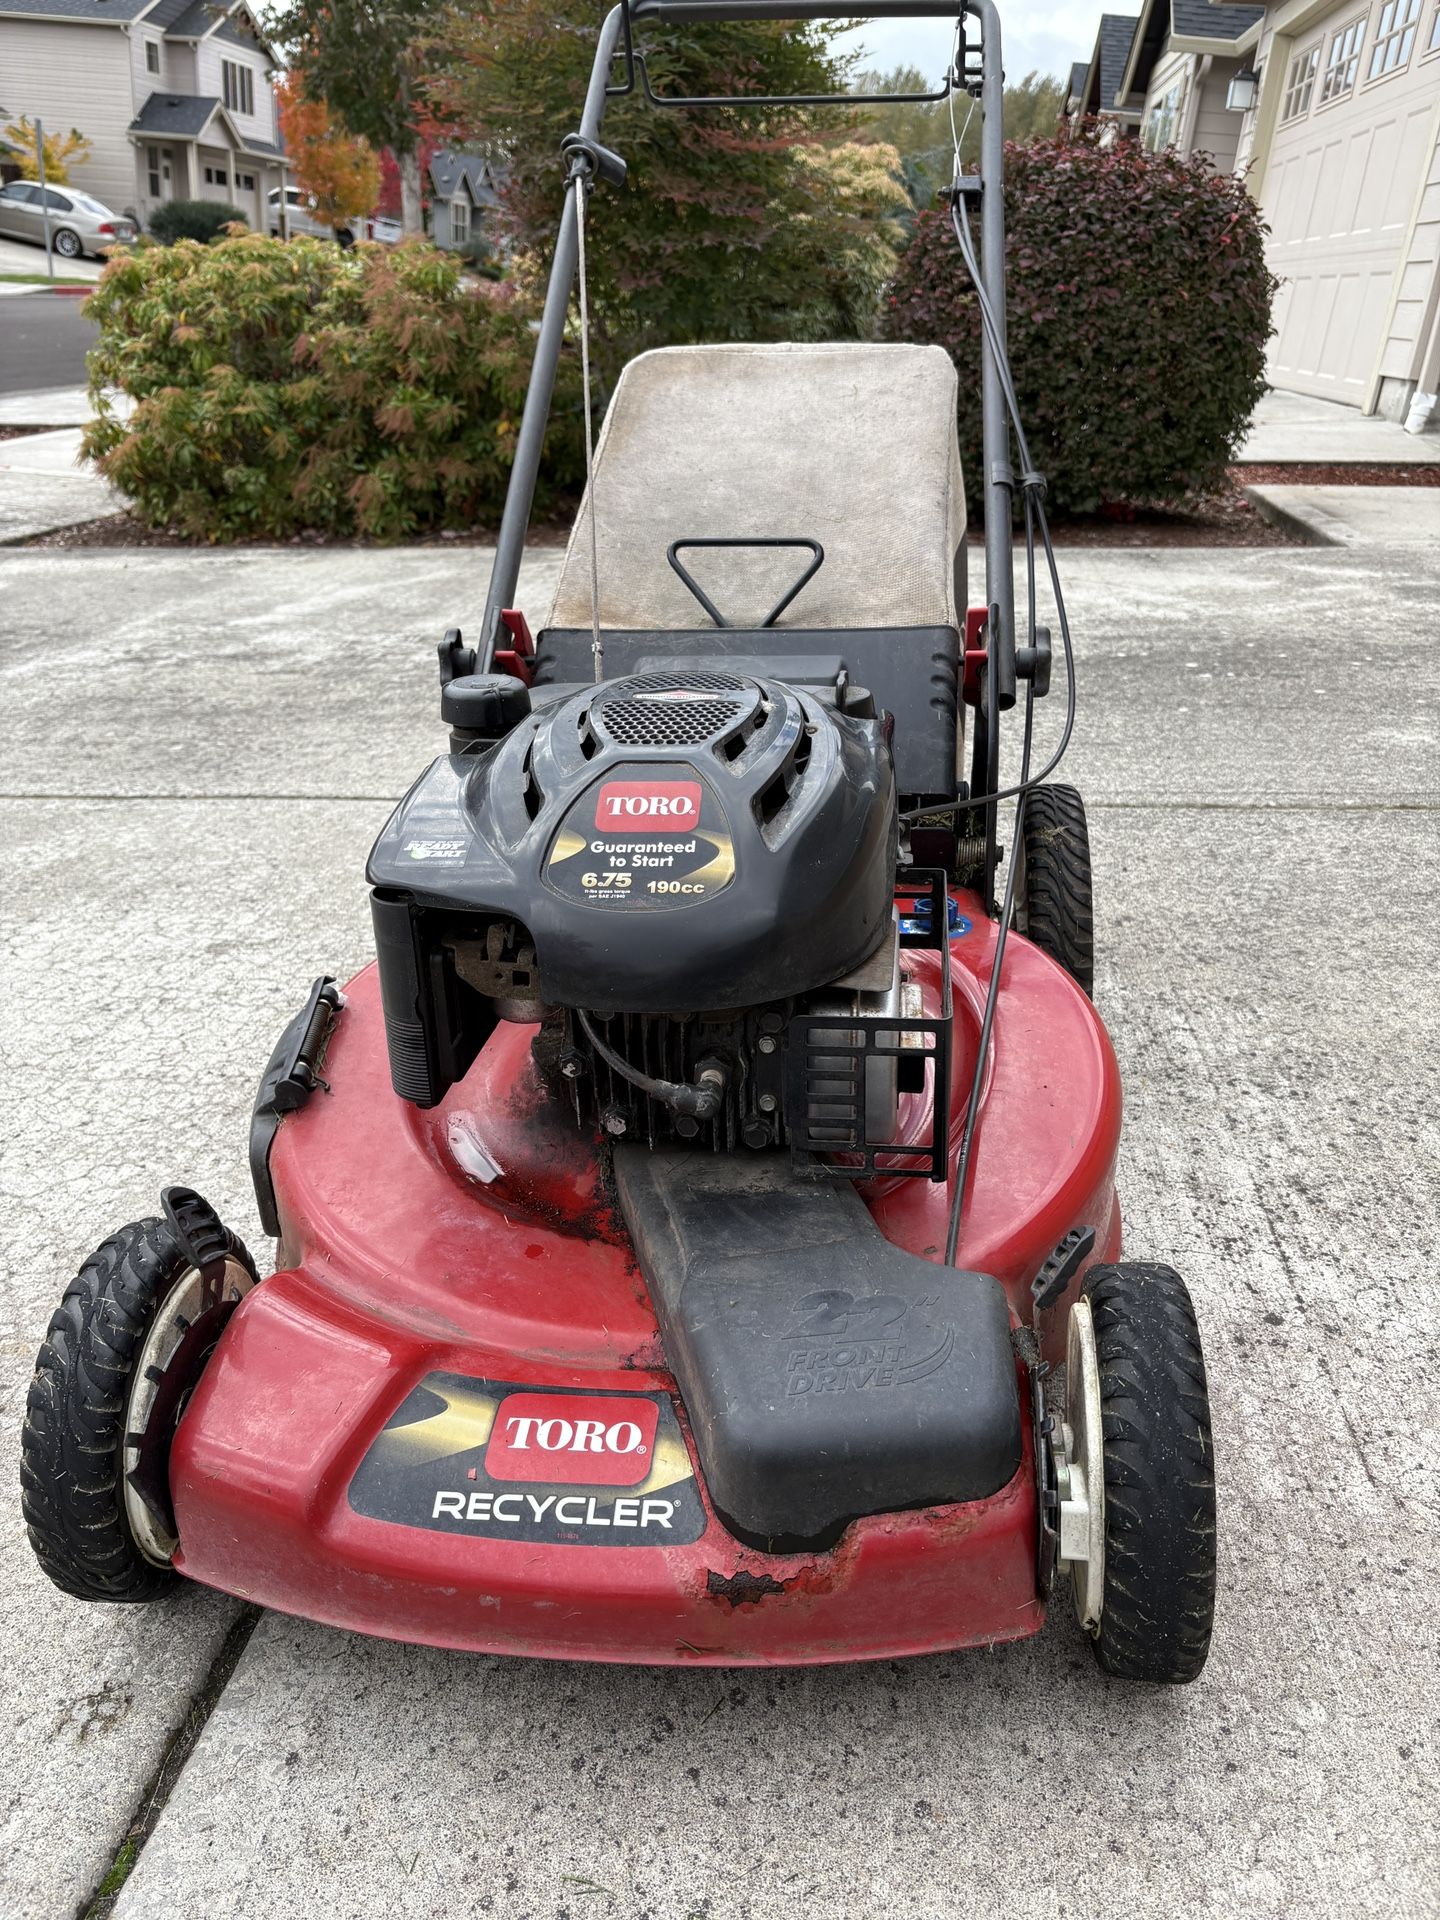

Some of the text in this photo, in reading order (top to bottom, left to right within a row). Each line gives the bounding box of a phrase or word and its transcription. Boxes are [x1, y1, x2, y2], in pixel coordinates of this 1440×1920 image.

[590, 840, 696, 854] Guaranteed
[609, 854, 674, 867] to Start
[581, 872, 705, 894] 6.75 190cc
[788, 1344, 906, 1372] FRONT
[788, 1368, 894, 1396] DRIVE
